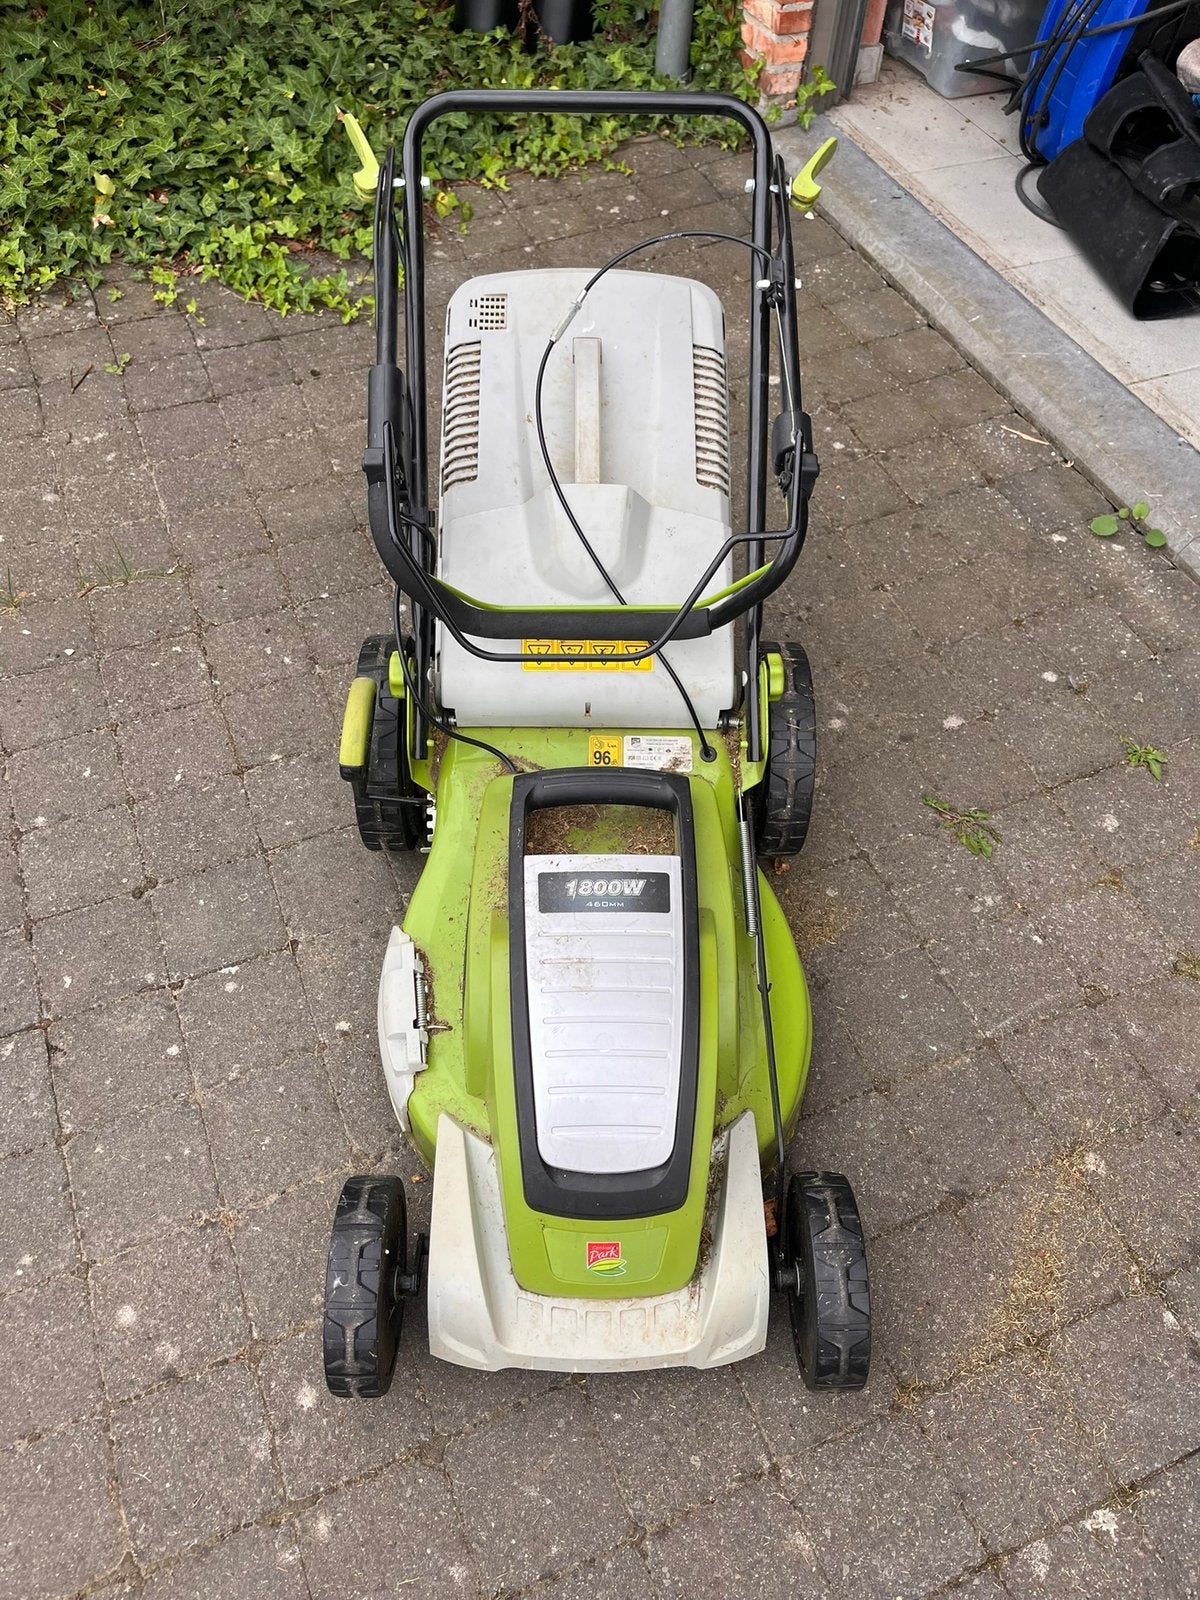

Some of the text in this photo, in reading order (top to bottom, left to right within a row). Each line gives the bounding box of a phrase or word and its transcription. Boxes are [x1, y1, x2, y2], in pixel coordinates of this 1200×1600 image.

[593, 750, 611, 765] 96
[565, 879, 647, 900] 1800W
[589, 1245, 618, 1263] Park
